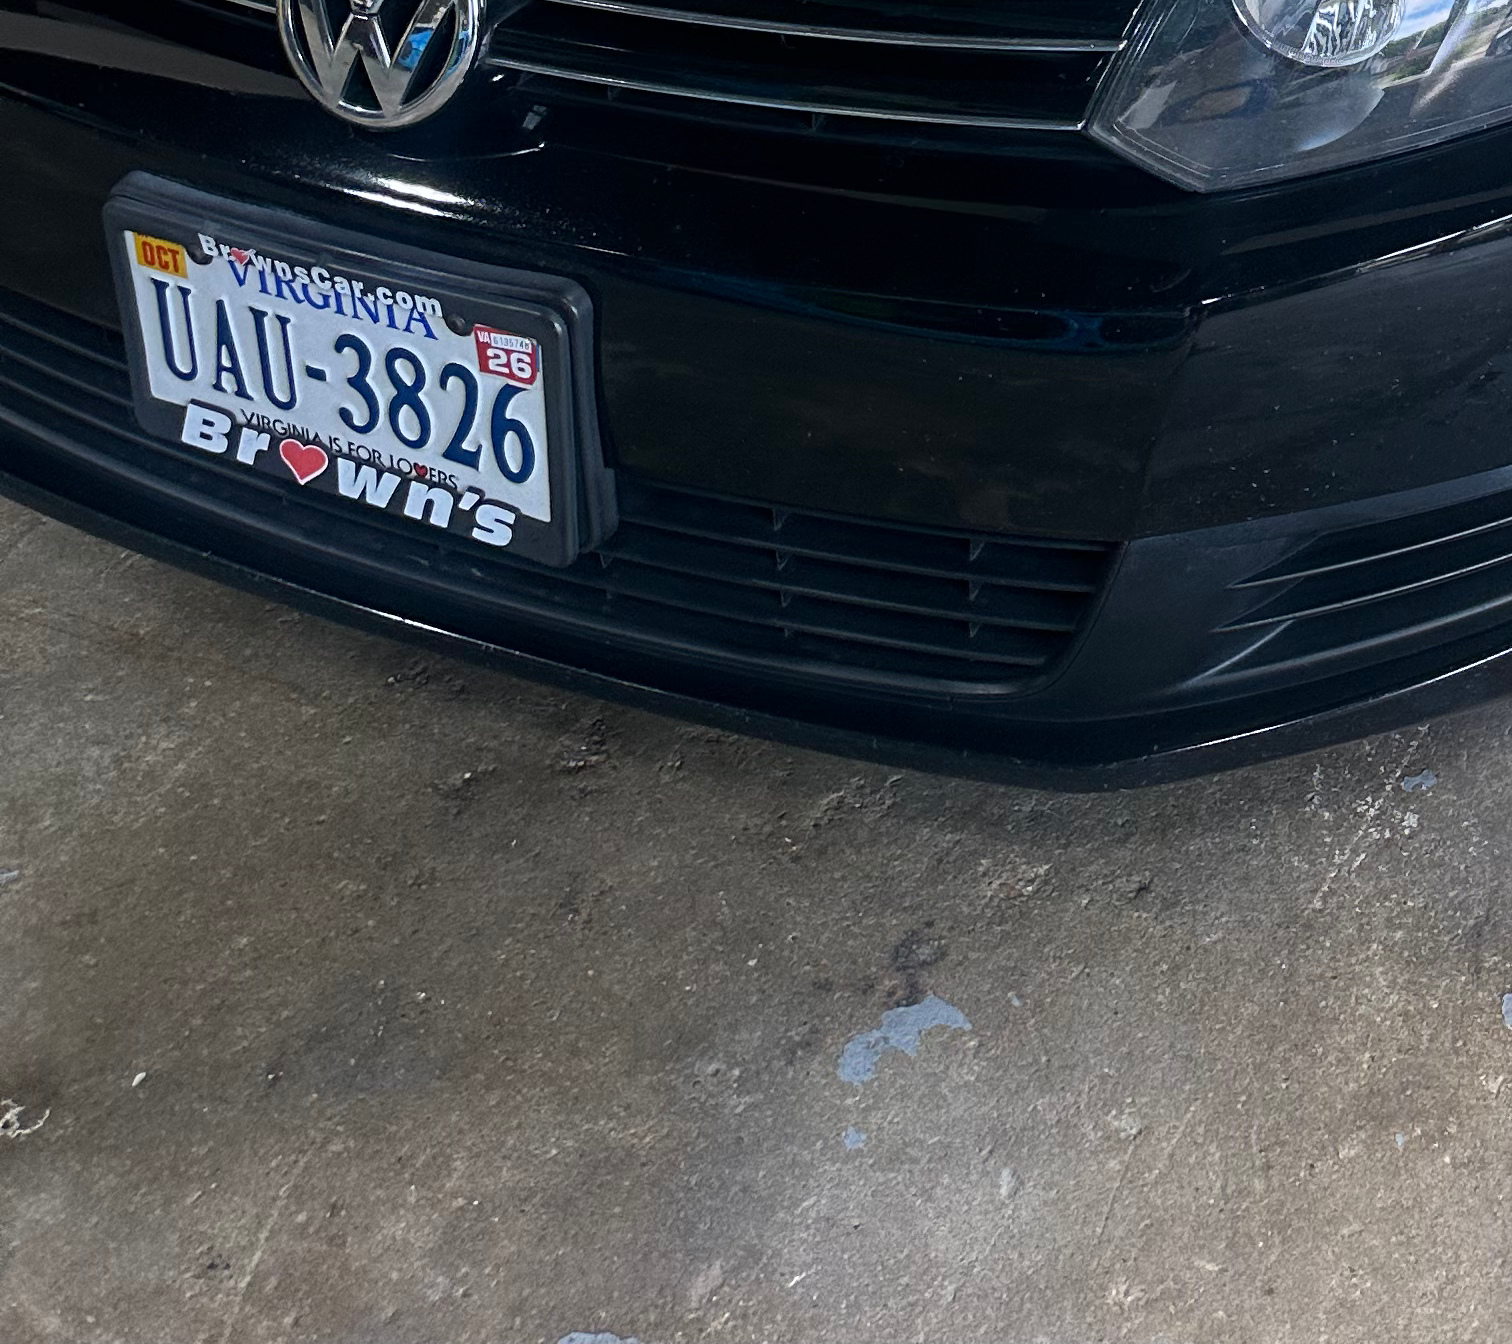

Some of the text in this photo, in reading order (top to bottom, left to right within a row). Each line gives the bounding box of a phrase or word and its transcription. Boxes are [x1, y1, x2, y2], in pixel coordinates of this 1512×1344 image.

[141, 241, 180, 274] OCT
[477, 330, 491, 344] VA
[152, 277, 537, 483] UAU-3826
[486, 348, 532, 379] 26
[240, 408, 323, 443] VIRGINIA
[328, 435, 342, 453] IS
[347, 441, 387, 468] FOR
